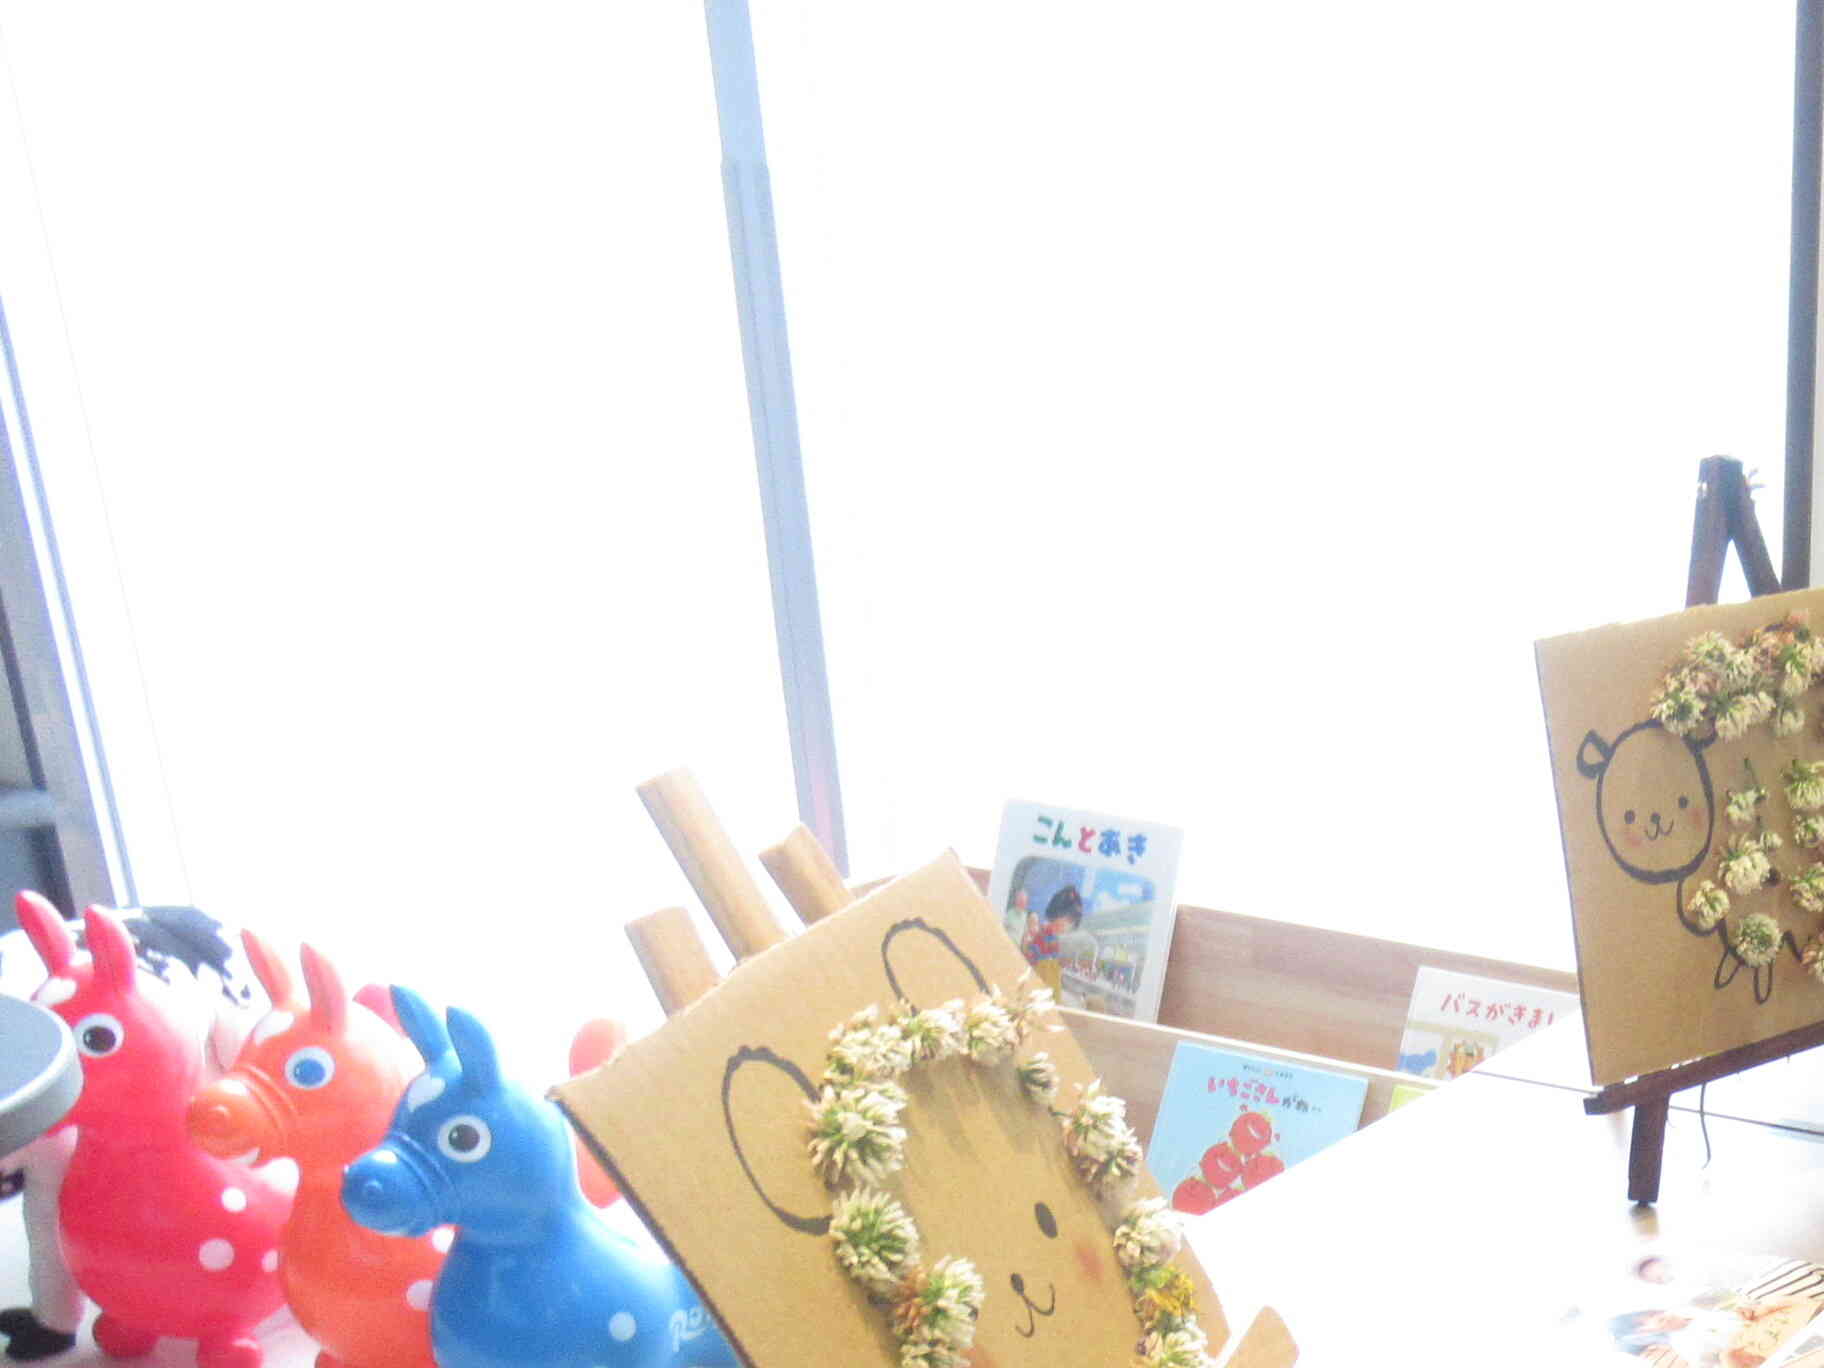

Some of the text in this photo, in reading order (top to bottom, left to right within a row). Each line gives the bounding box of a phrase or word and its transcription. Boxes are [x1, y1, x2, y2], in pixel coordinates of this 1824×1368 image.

[1033, 815, 1147, 865] こんとあき
